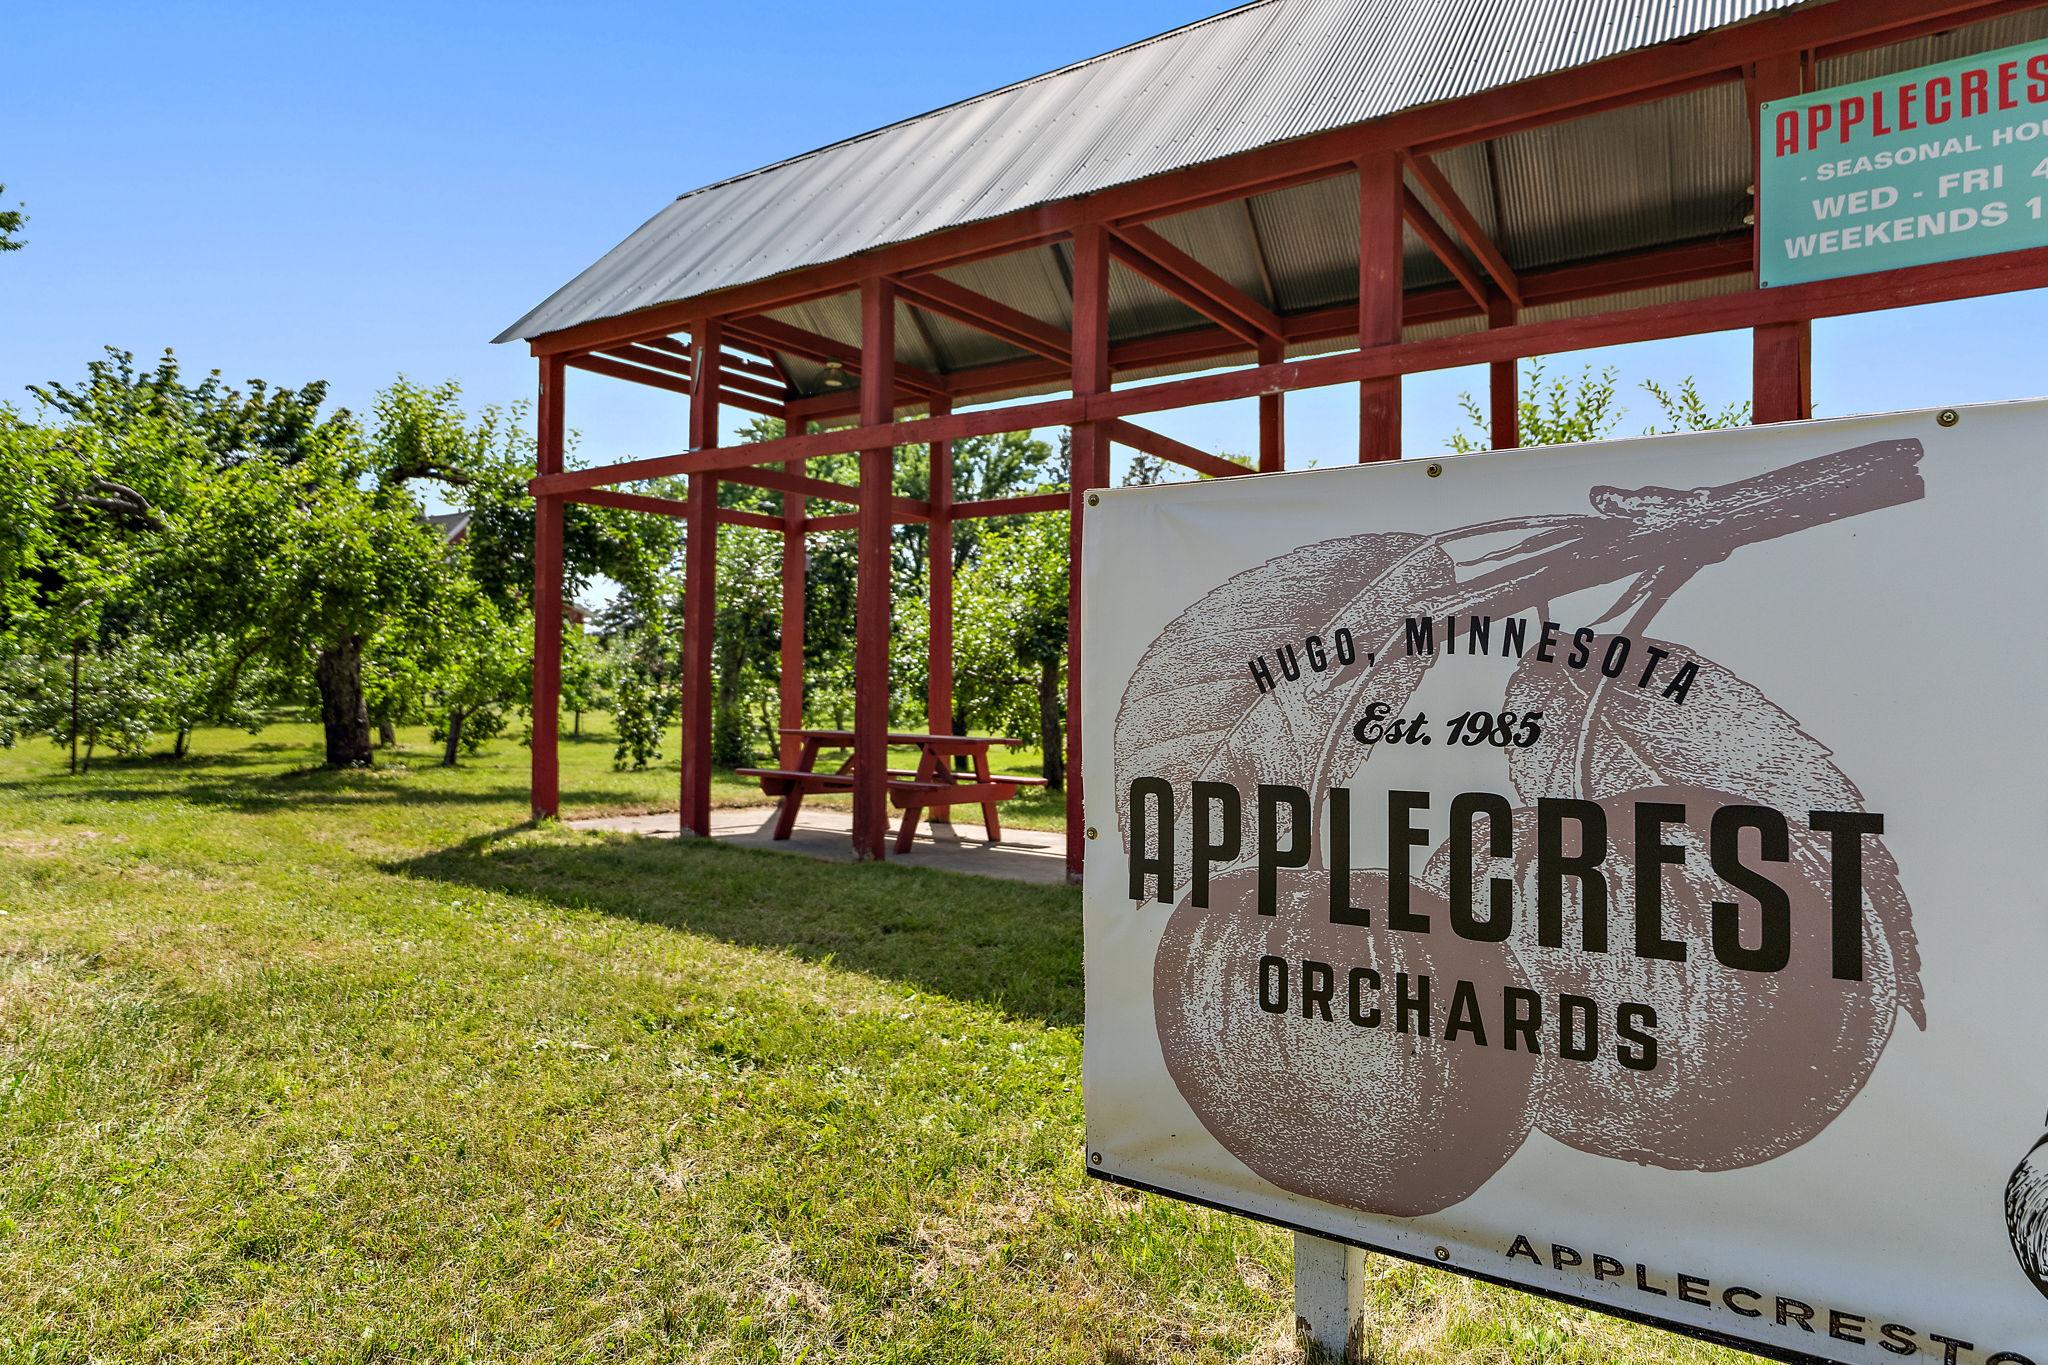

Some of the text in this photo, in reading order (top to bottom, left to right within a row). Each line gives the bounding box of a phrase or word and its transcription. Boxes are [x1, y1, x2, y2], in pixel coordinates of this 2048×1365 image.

[1816, 134, 1981, 181] SEASONAL
[1992, 120, 2048, 147] HO
[1812, 186, 1898, 220] WED
[1938, 165, 2003, 198] FRI
[1784, 201, 2009, 259] WEEKENDS
[1248, 615, 1701, 706] HUGO, MINNESOTA
[1353, 701, 1544, 749] Est. 1985
[1129, 776, 1885, 983] APPLECREST
[1259, 954, 1658, 1072] ORCHARDS
